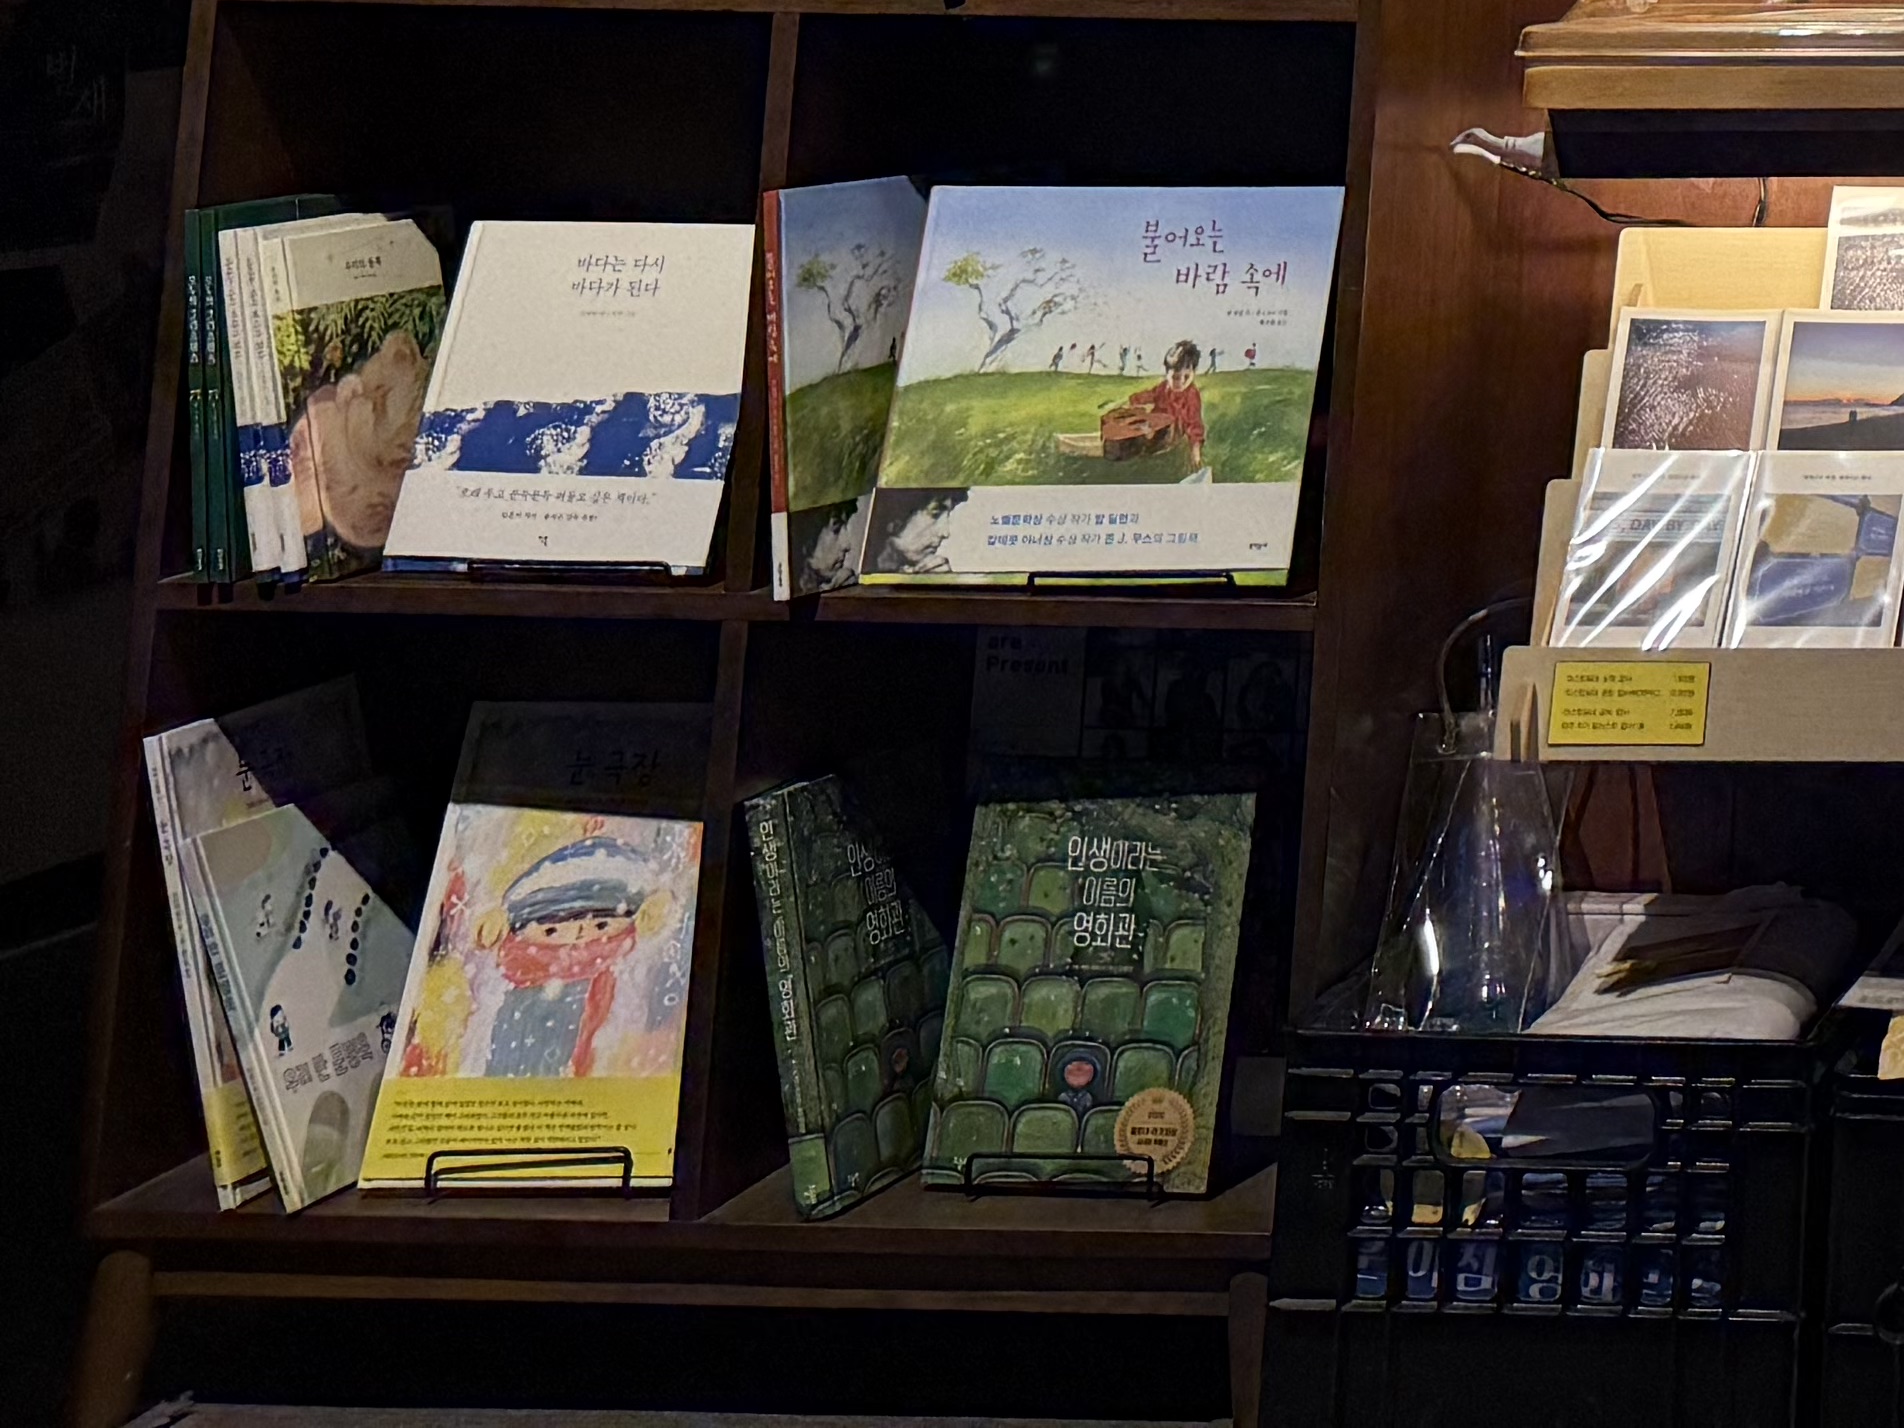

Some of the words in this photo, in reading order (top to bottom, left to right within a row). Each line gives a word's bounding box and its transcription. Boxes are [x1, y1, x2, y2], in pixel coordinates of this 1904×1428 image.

[1141, 218, 1225, 263] 불어오는
[577, 254, 627, 272] 바다는
[634, 255, 666, 274] 다시
[1175, 261, 1230, 295] 바람
[1239, 260, 1288, 298] 속에
[571, 278, 620, 296] 바다가
[626, 277, 661, 298] 된다
[1067, 835, 1168, 872] 인생이라는
[1082, 876, 1137, 908] 이름의
[1073, 911, 1139, 949] 영화관
